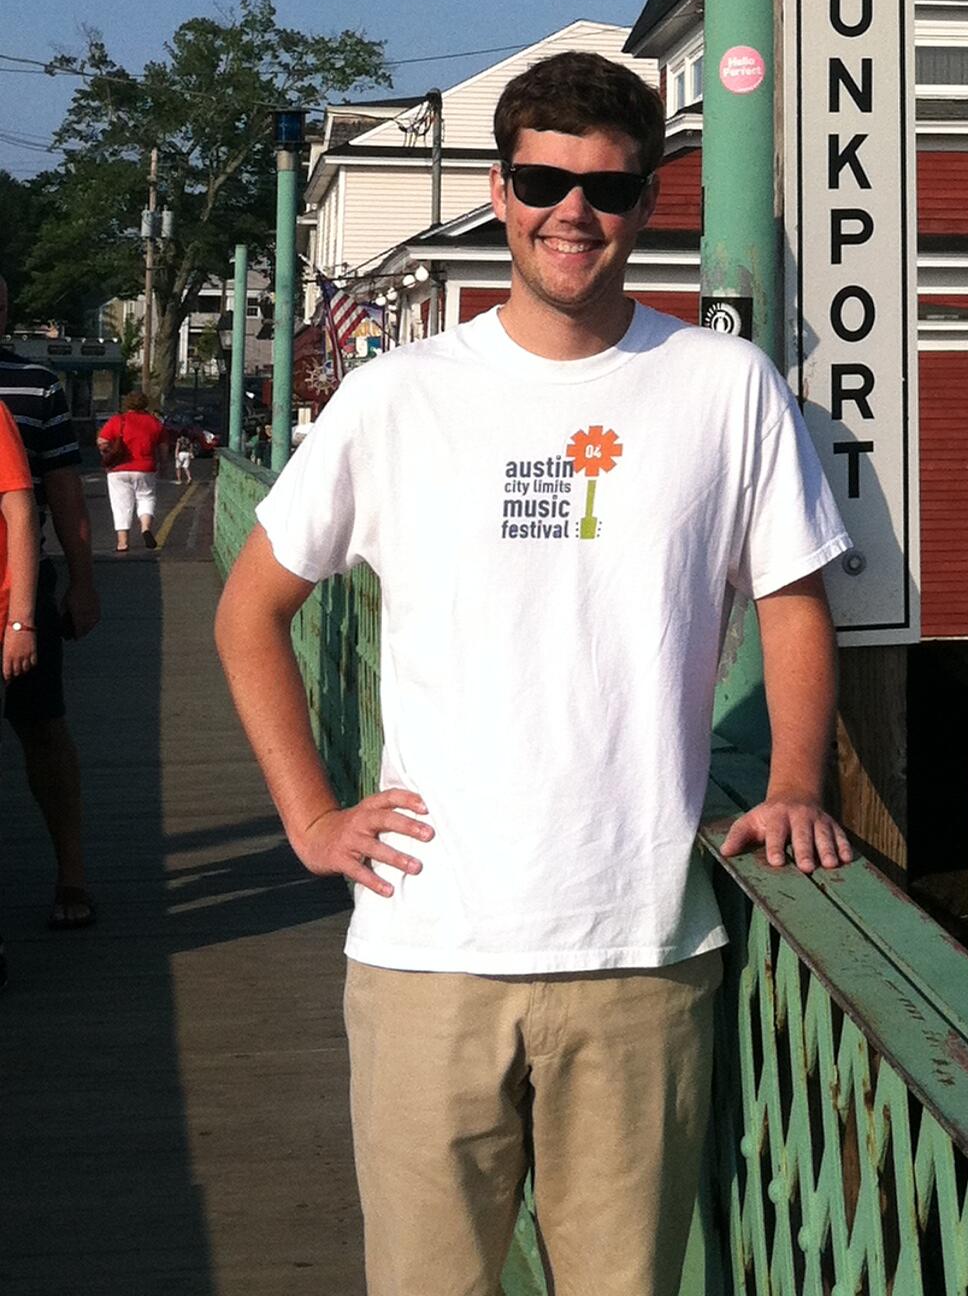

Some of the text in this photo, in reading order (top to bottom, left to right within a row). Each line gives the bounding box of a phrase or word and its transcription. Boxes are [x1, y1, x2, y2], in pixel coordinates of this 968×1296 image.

[727, 56, 756, 68] Hello
[585, 444, 602, 459] 04
[505, 455, 573, 478] austin
[504, 479, 571, 495] city limits
[503, 495, 571, 518] music
[501, 520, 570, 539] festival
